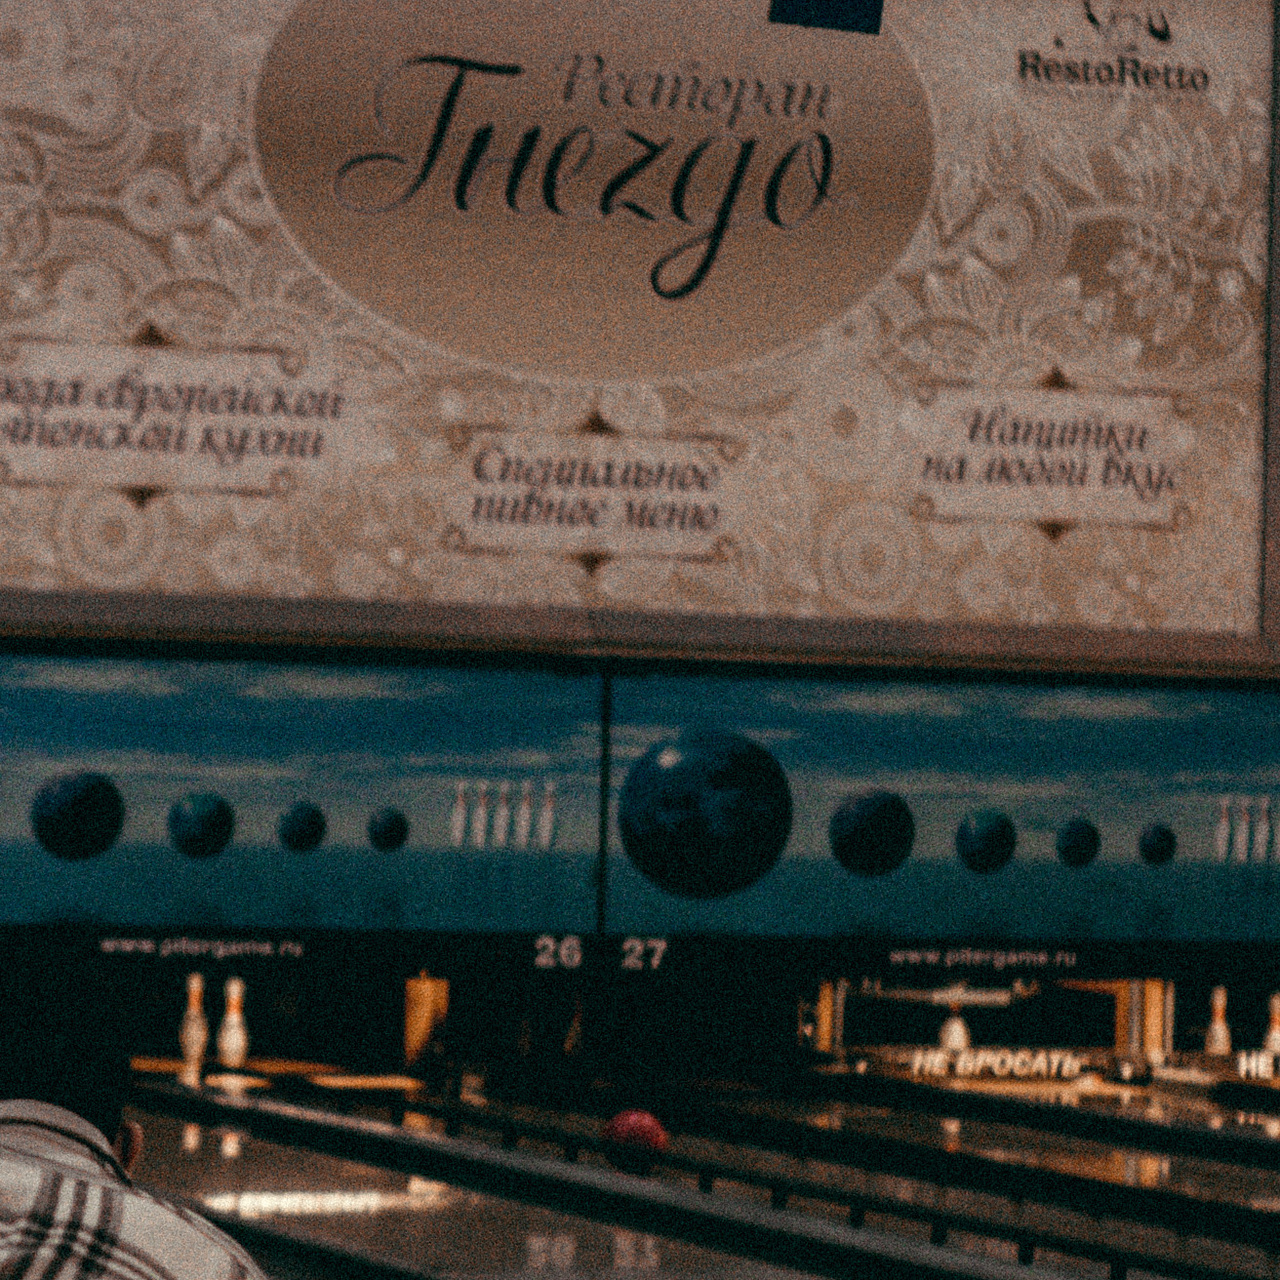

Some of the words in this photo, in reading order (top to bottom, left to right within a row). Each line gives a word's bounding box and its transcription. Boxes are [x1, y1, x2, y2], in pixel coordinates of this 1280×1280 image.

[555, 52, 831, 129] Ресторан
[1018, 48, 1211, 95] RestoRetto
[534, 935, 583, 968] 26
[622, 937, 668, 970] 27
